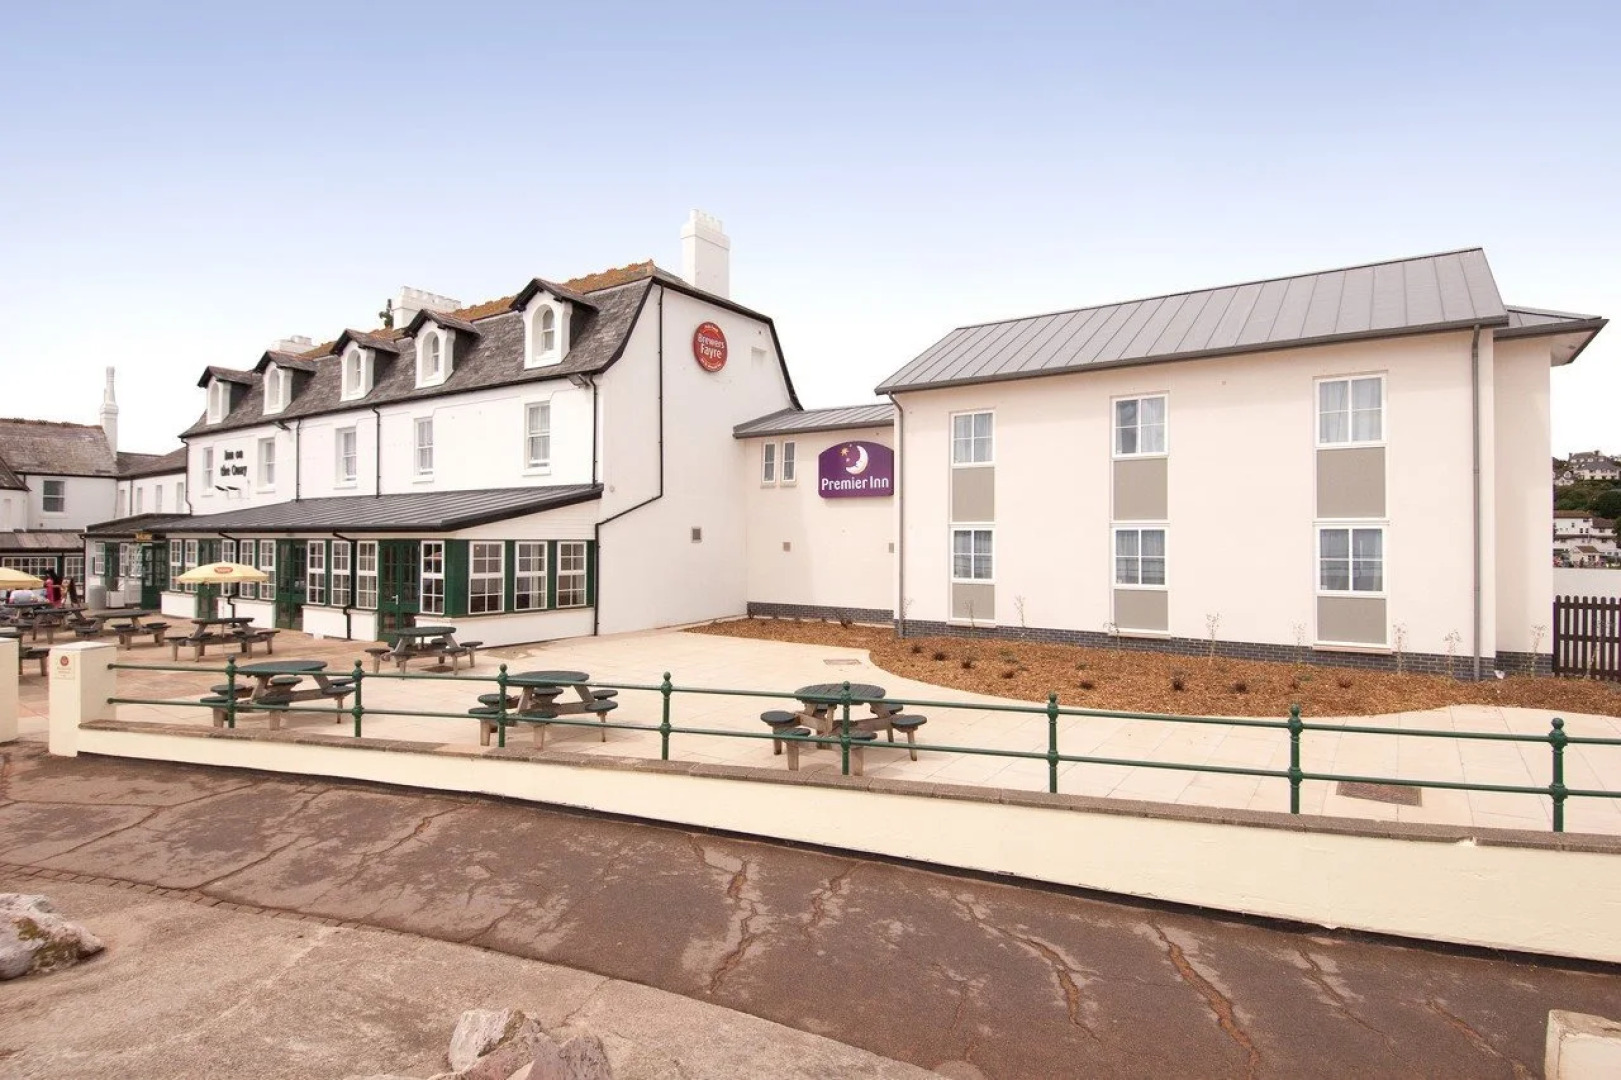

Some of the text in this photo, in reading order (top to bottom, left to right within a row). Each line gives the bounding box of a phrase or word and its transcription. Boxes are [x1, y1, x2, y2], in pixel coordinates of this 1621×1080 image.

[697, 332, 724, 349] Brewers
[700, 343, 722, 359] Fayre
[821, 475, 889, 491] Premier Inn
